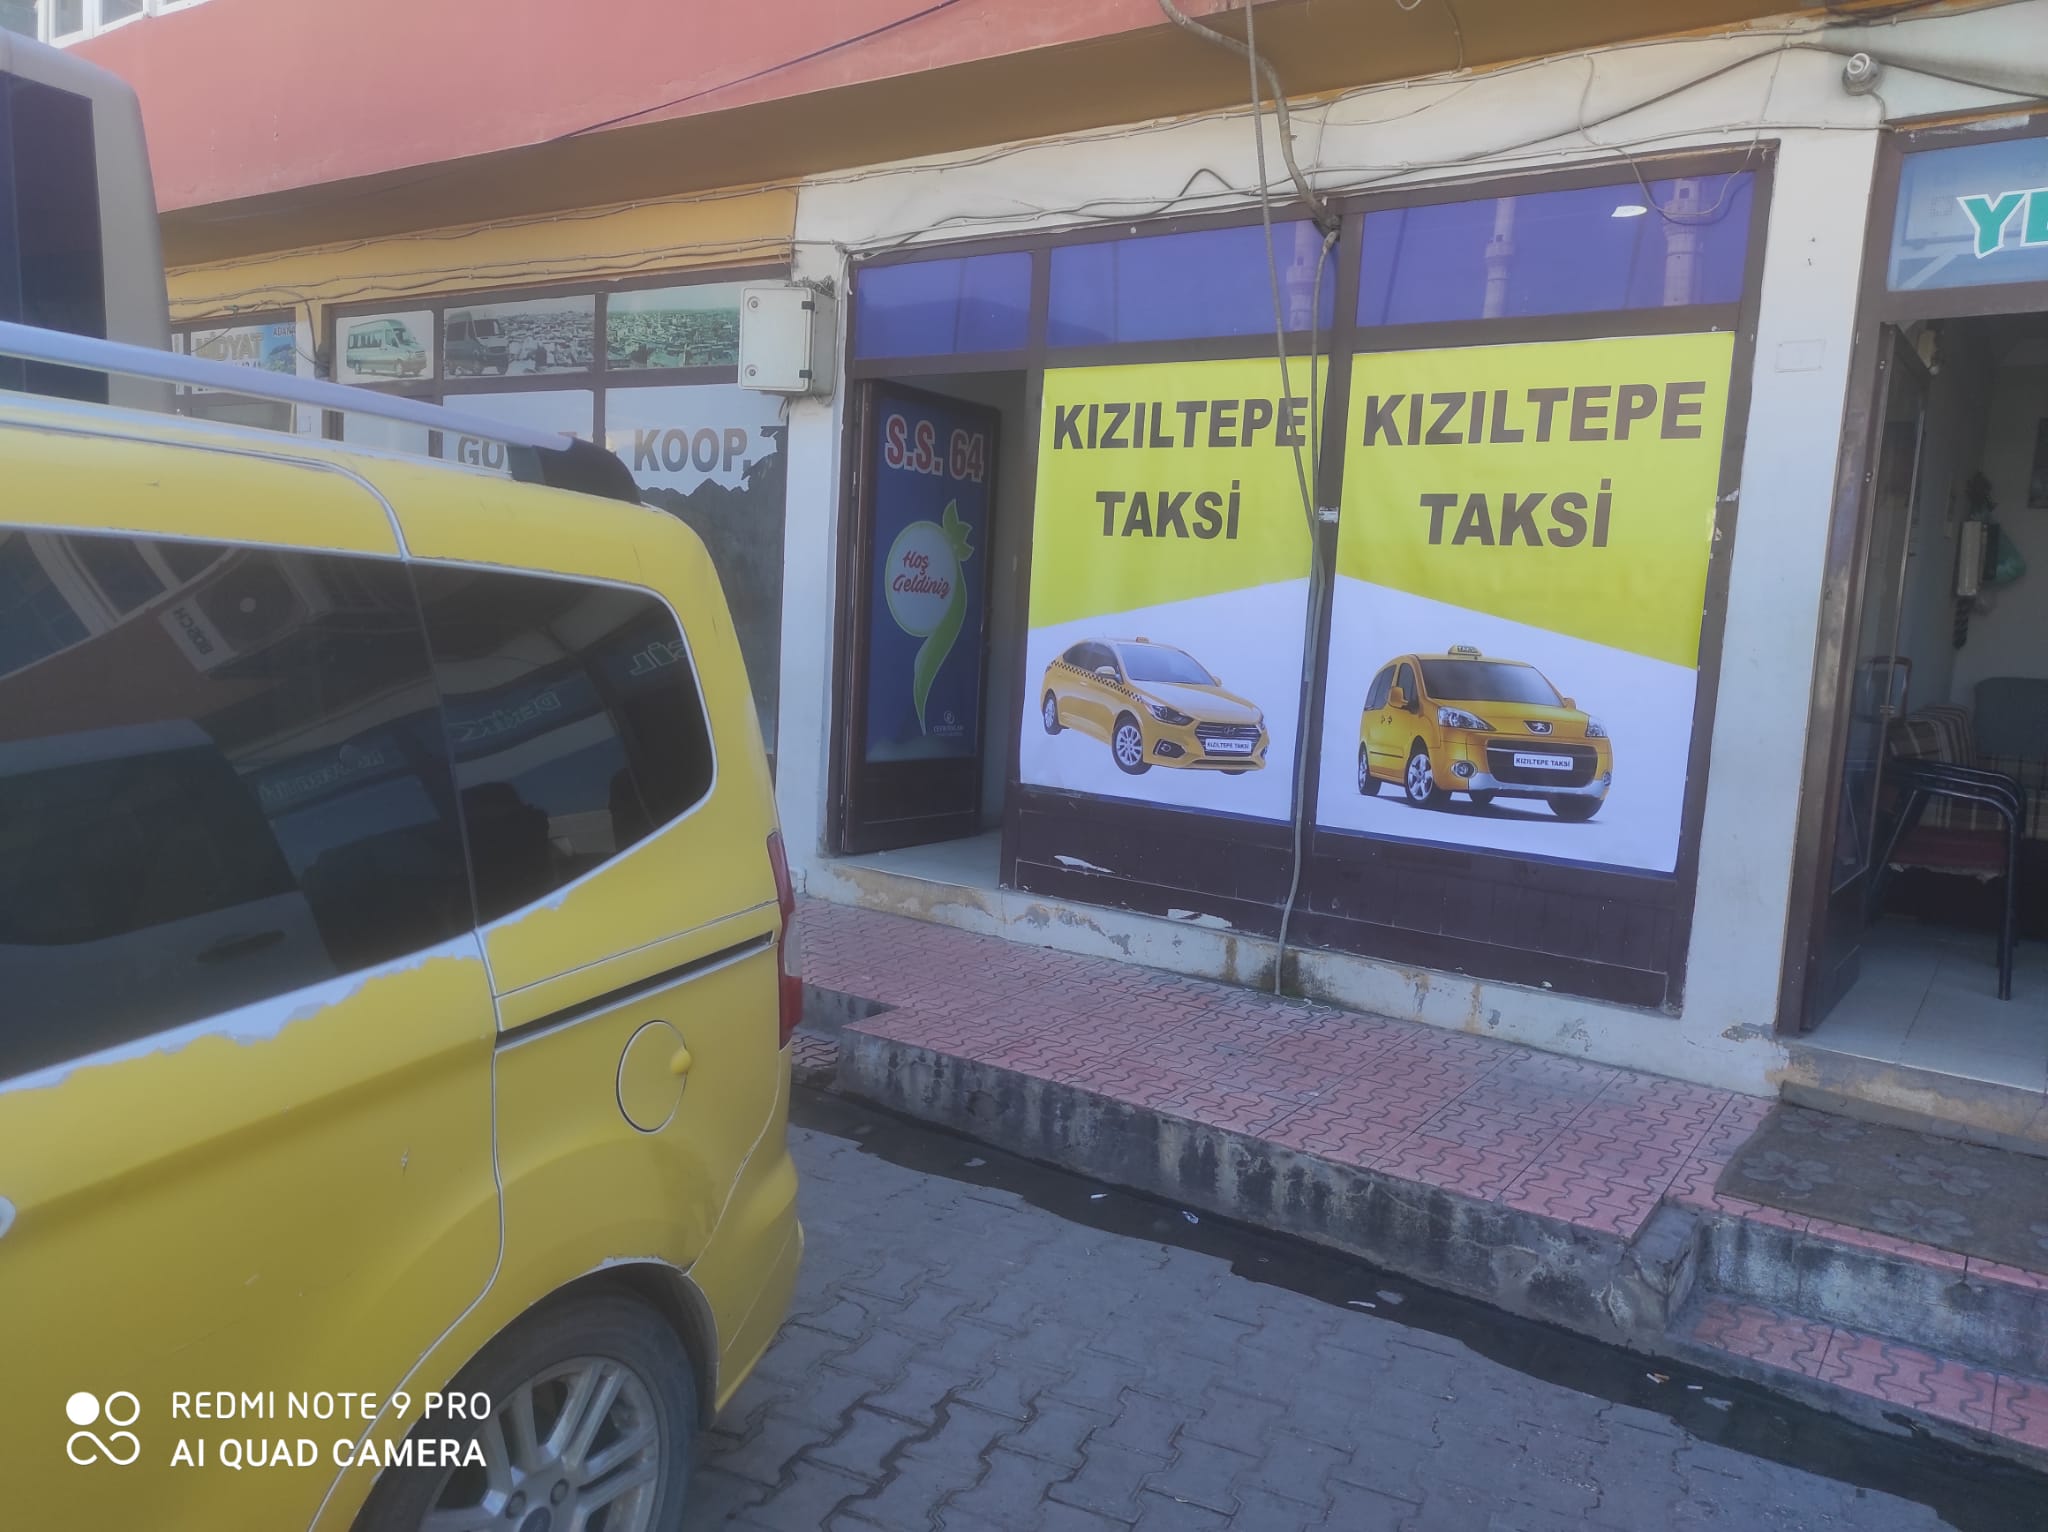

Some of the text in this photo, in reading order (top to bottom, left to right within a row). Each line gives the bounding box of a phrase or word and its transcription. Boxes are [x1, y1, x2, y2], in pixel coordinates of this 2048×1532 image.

[1052, 396, 1309, 450] KIZILTEPE
[1362, 381, 1706, 446] KIZILTEPE
[885, 413, 985, 483] S.S. 64
[1095, 479, 1242, 540] TAKSİ
[1419, 478, 1613, 548] TAKSİ
[892, 574, 951, 599] Geldiniz
[902, 550, 929, 576] Hoş
[1515, 757, 1549, 766] KIZILTEPE
